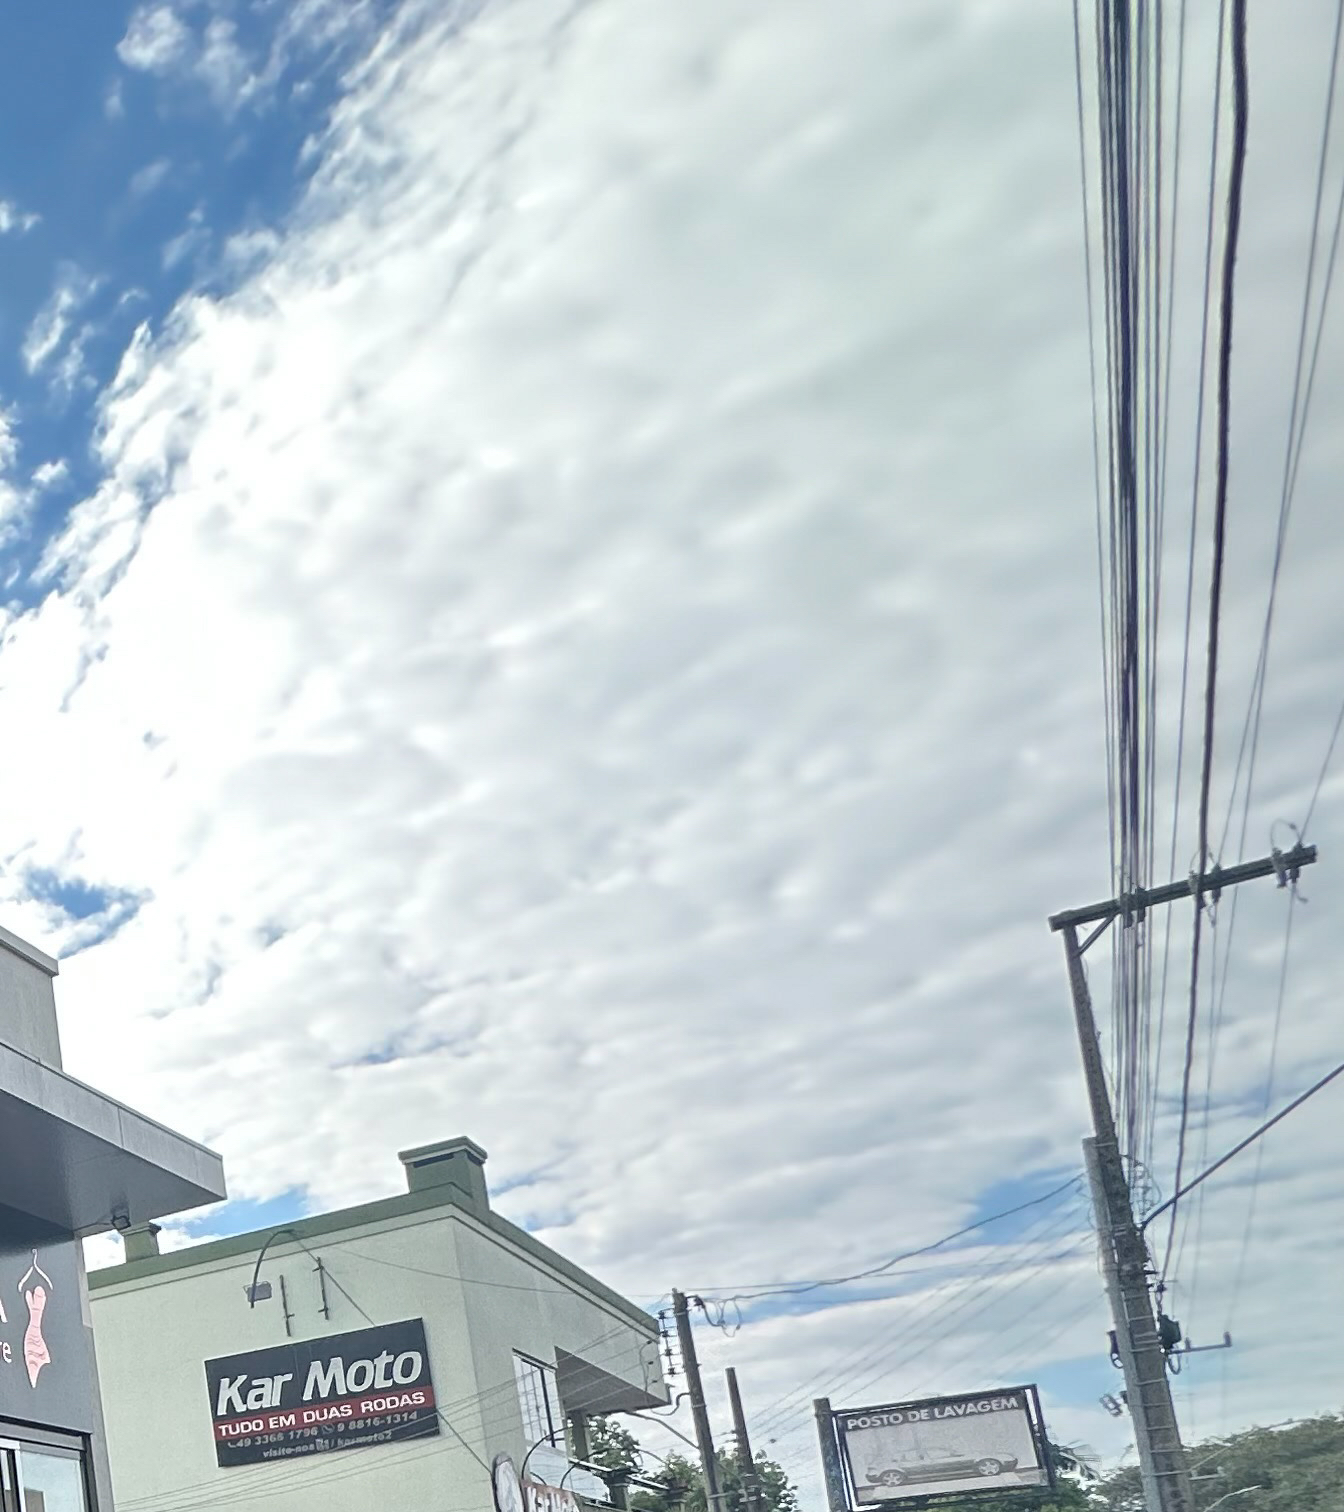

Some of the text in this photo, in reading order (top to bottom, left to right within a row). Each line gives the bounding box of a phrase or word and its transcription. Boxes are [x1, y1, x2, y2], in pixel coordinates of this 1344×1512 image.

[217, 1349, 422, 1416] Kar Moto
[219, 1391, 425, 1437] TUDO EM DUAS RODAS
[847, 1397, 1019, 1430] POSTO DE LAVAGEM
